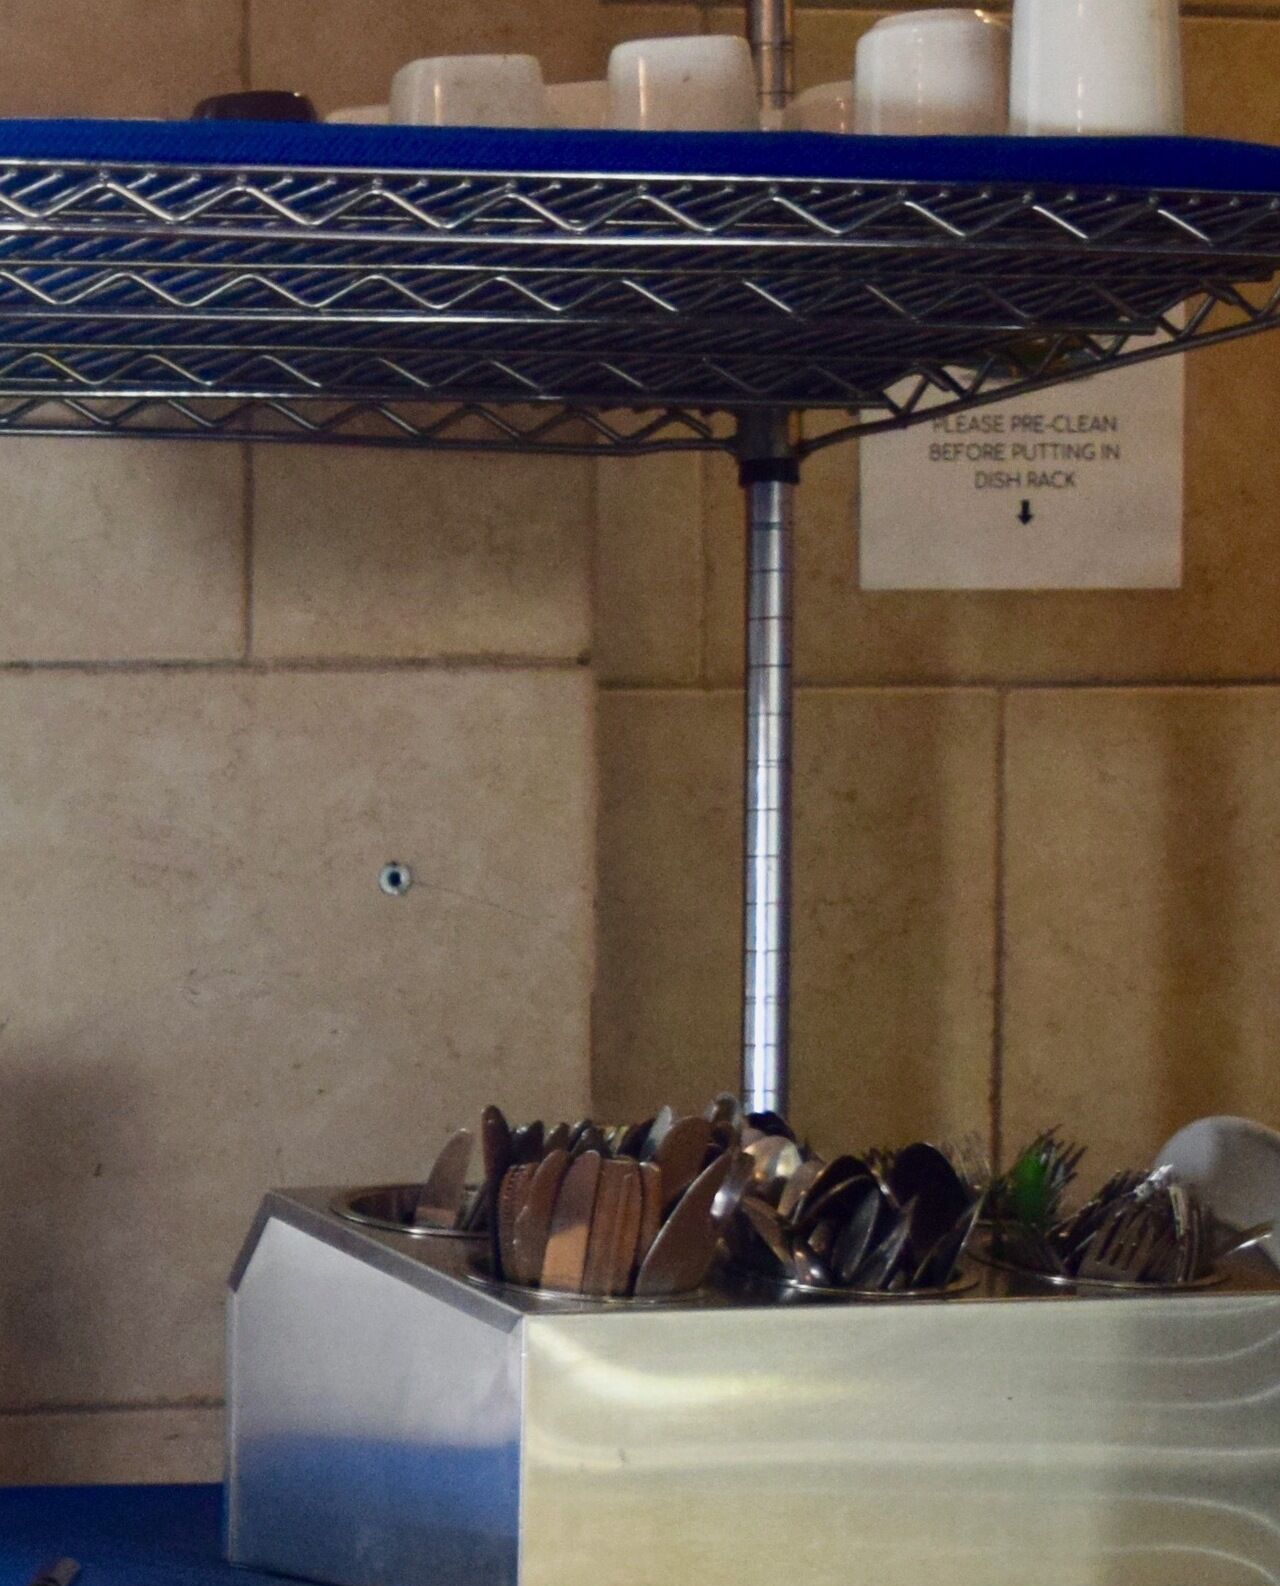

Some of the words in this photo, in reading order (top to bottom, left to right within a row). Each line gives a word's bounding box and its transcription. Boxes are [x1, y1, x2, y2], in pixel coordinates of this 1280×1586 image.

[932, 413, 1005, 434] PLEASE
[1010, 413, 1118, 434] PRE-CLEAN
[928, 442, 1006, 462] BEFORE
[1011, 442, 1096, 462] PUTTING
[1100, 442, 1122, 461] IN
[974, 471, 1022, 490] DISH
[1027, 471, 1076, 489] RACK
